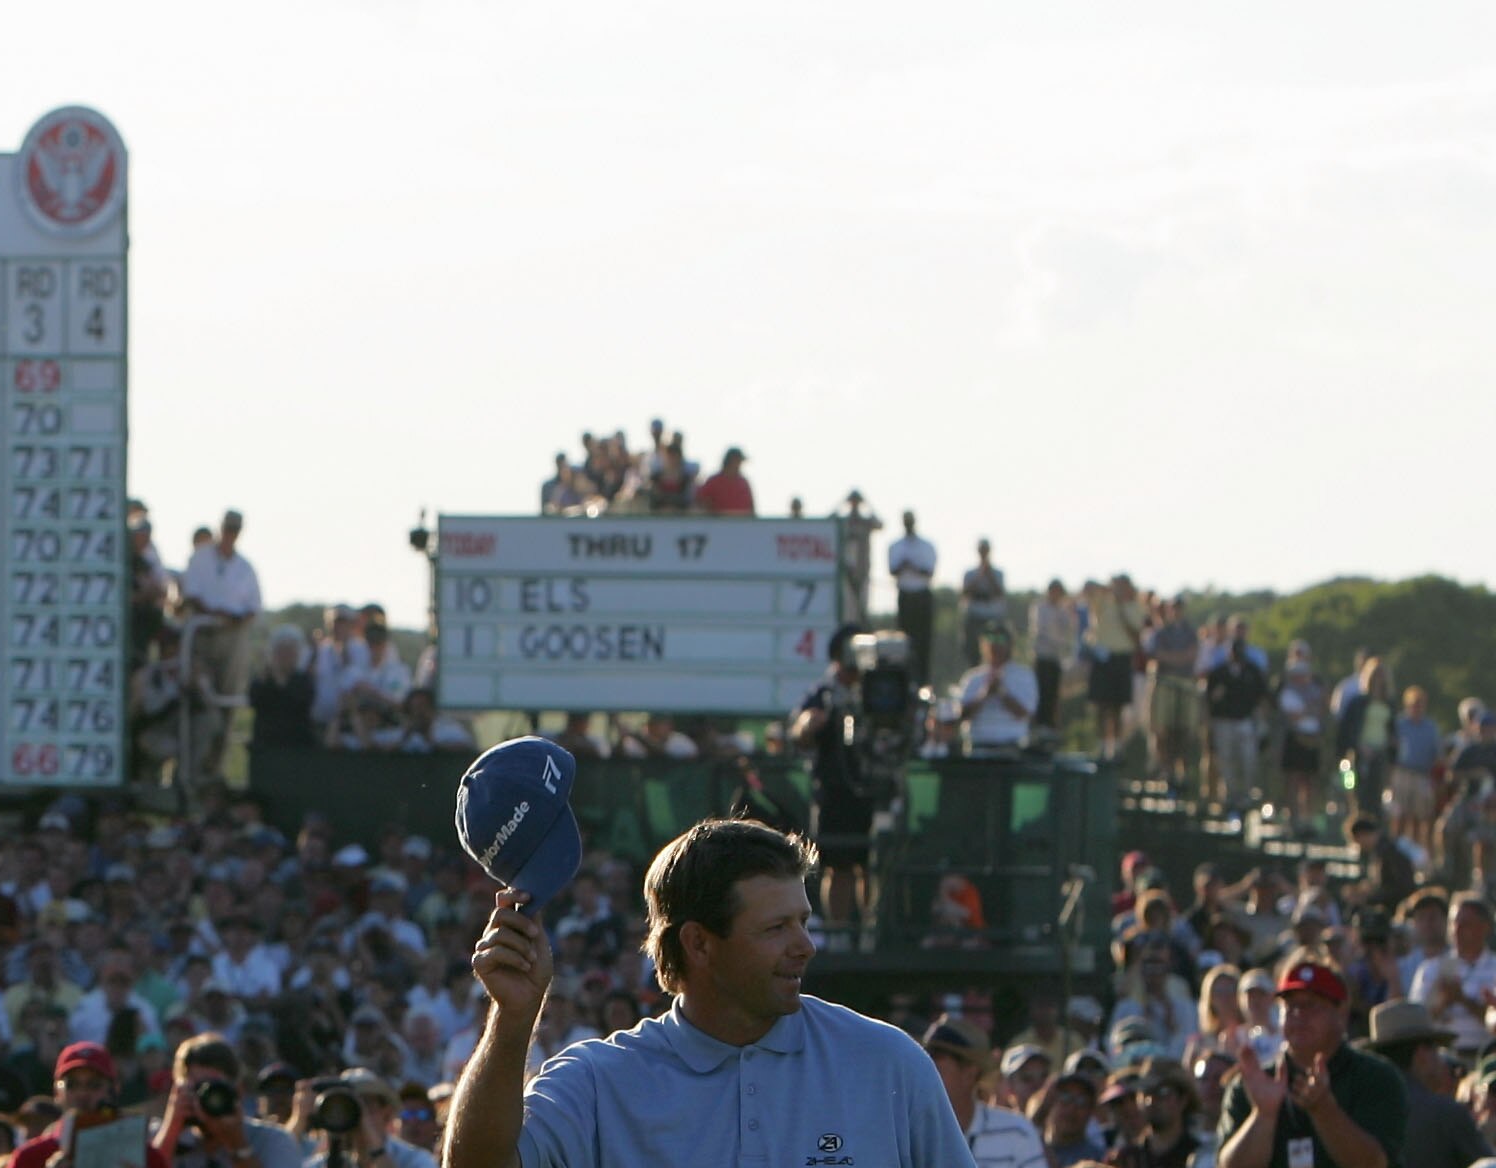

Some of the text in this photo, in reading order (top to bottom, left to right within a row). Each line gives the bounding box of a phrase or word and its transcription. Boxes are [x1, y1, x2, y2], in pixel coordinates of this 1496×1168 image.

[16, 267, 57, 299] RD
[79, 267, 118, 299] RD
[24, 306, 44, 343] 3
[84, 306, 105, 342] 4
[14, 360, 61, 392] 69
[14, 403, 63, 435] 70
[13, 446, 59, 478] 73
[69, 446, 111, 478] 71
[14, 487, 61, 518] 74
[68, 487, 114, 519] 72
[12, 529, 62, 562] 70
[69, 529, 115, 561] 74
[568, 535, 652, 558] THRU
[678, 535, 707, 558] 17
[776, 534, 836, 560] TOTAL
[13, 572, 58, 604] 72
[69, 571, 118, 603] 77
[455, 580, 816, 612] 10 ELS 7
[13, 614, 60, 646] 74
[68, 615, 118, 647] 70
[520, 626, 665, 660] GOOSEN
[795, 628, 814, 660] 4
[11, 657, 51, 689] 71
[68, 659, 114, 690] 74
[12, 698, 60, 730] 74
[67, 700, 114, 732] 76
[12, 745, 59, 775] 66
[68, 745, 118, 778] 79
[479, 800, 531, 866] ylorMade
